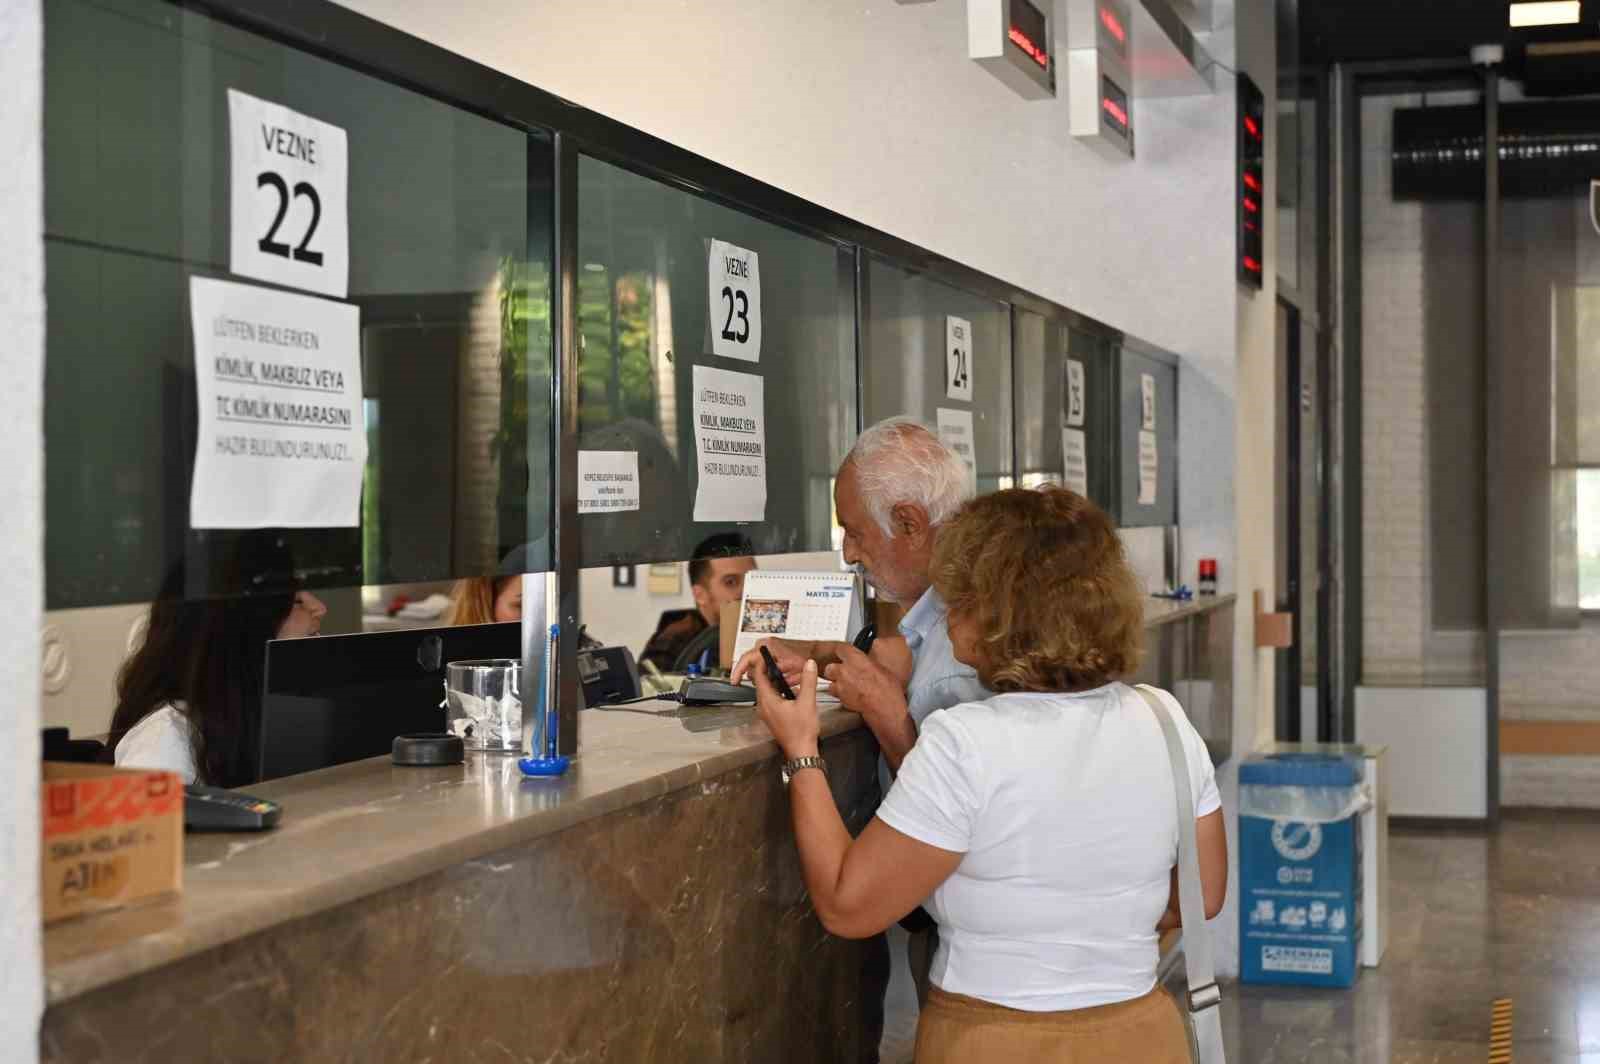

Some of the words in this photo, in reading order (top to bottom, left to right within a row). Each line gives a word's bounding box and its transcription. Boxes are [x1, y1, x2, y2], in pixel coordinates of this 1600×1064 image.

[261, 124, 316, 164] VEZNE
[256, 171, 324, 266] 22
[726, 256, 748, 278] VEZNE
[213, 315, 255, 341] LÜTFEN
[257, 324, 319, 350] BEKLERKEN
[722, 286, 750, 344] 23
[260, 361, 311, 387] MAKBUZ
[313, 367, 344, 390] VEYA
[953, 348, 967, 390] 24
[233, 395, 270, 419] KİMLİK
[272, 400, 352, 426] NUMARASINI
[720, 415, 743, 430] MAKBUZ
